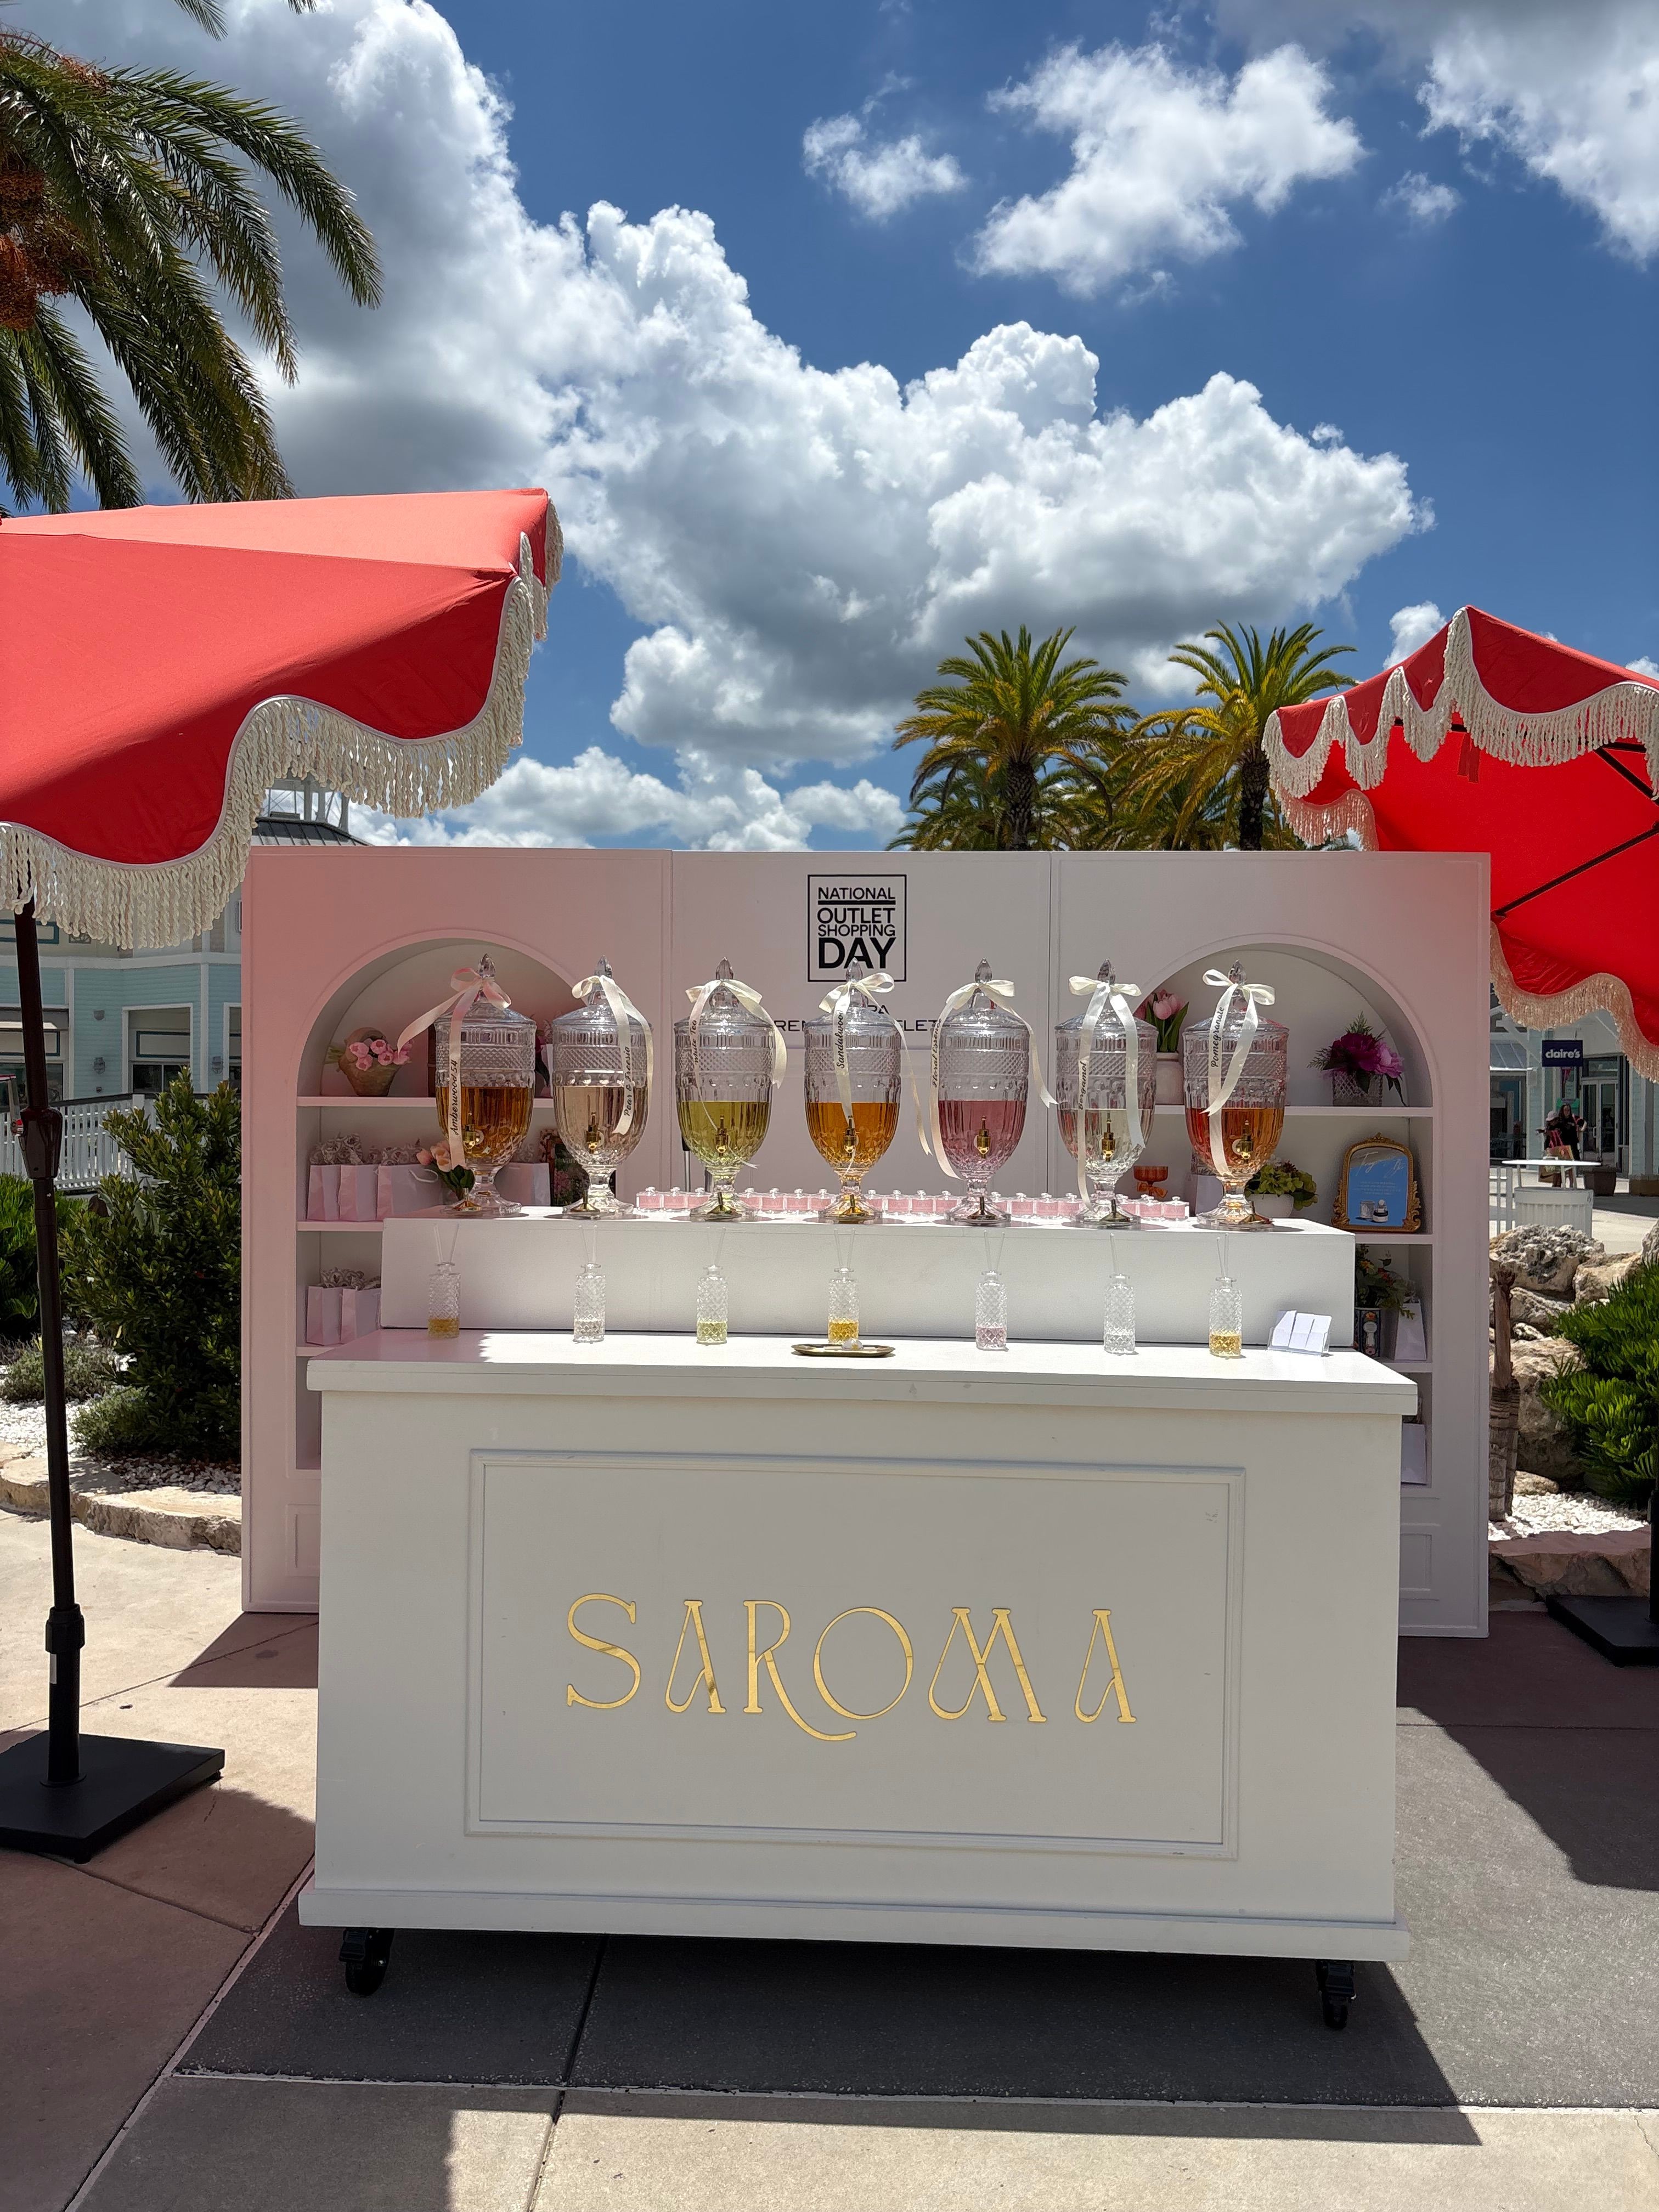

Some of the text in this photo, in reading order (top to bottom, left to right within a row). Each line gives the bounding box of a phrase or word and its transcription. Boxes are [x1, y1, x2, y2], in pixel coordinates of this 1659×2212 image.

[818, 887, 896, 900] NATIONAL
[817, 907, 896, 924] OUTLET
[817, 924, 896, 937] SHOPPING
[818, 937, 897, 969] DAY
[1210, 1007, 1225, 1068] Pomegranate
[1545, 1048, 1581, 1058] claire's
[625, 1084, 633, 1092] &
[1078, 1060, 1087, 1110] Bergamot
[450, 1059, 459, 1136] Amberwood 54
[623, 1094, 633, 1117] Pear
[567, 1592, 1137, 1741] SAROMA
